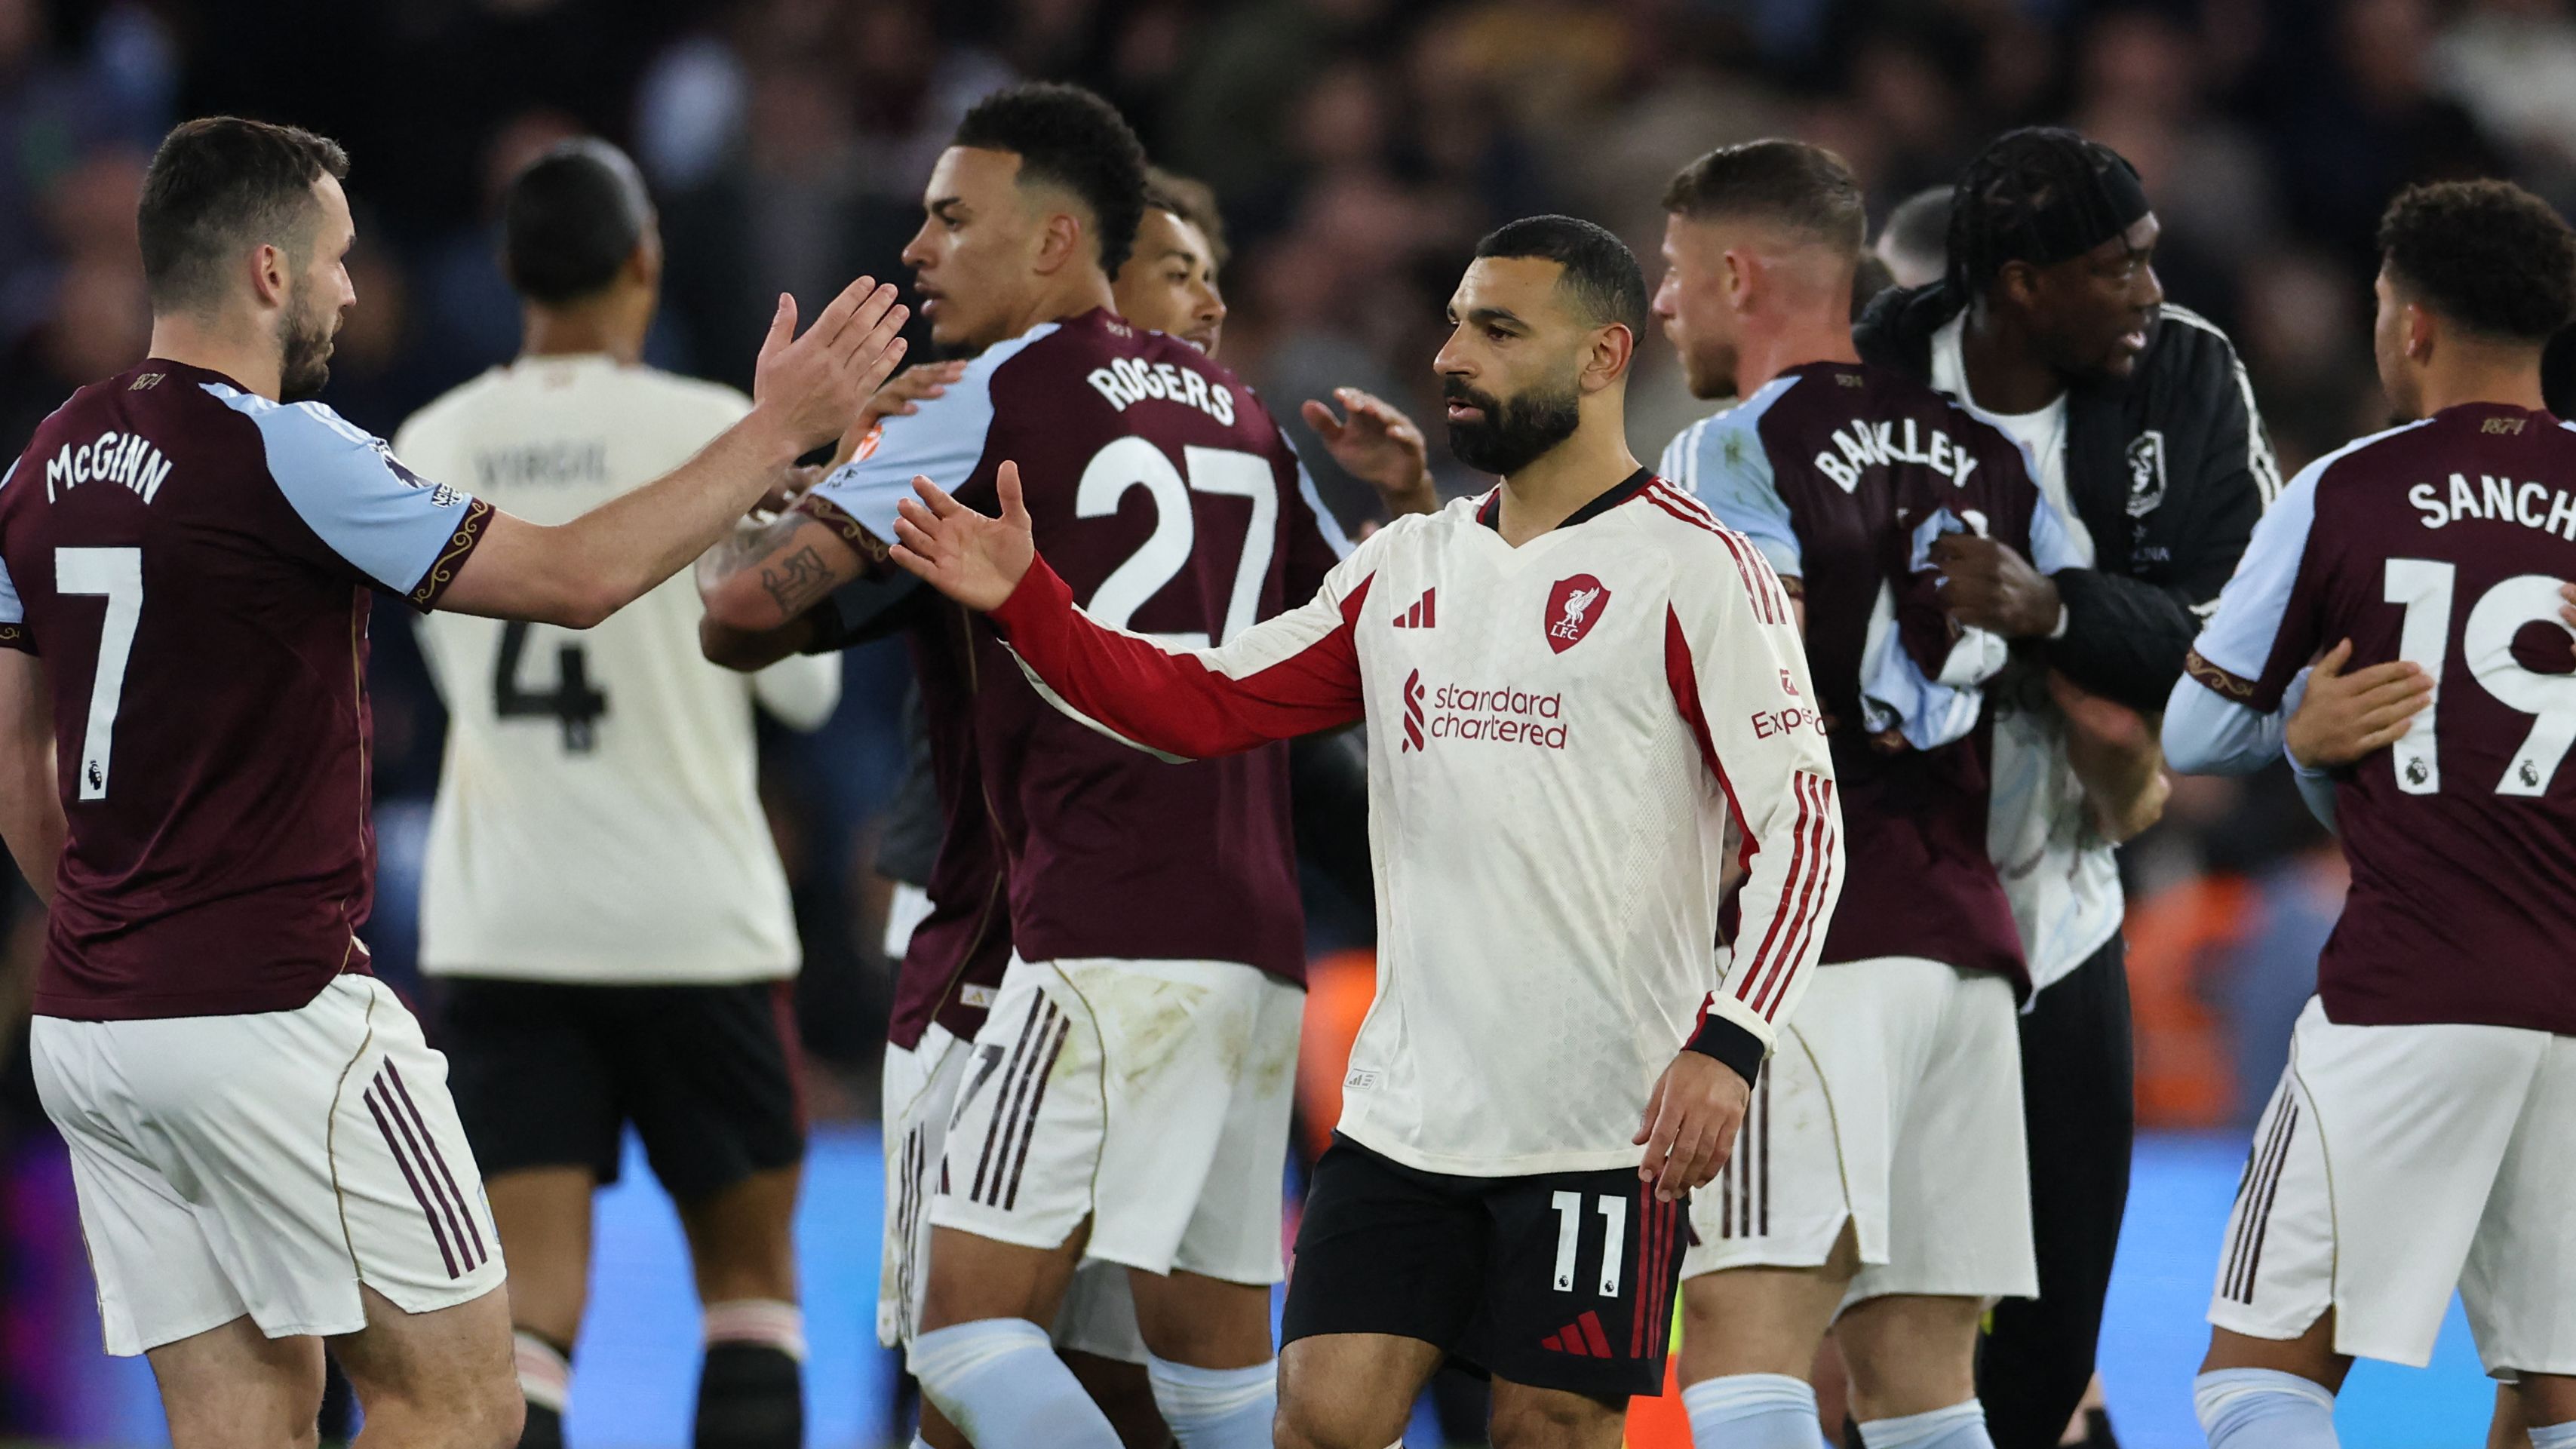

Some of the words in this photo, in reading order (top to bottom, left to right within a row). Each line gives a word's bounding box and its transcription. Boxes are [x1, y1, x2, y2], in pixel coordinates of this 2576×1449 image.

[1087, 357, 1235, 426] ROGERS
[1814, 418, 1979, 494] BARKLEY
[1076, 434, 1279, 653] 27
[54, 547, 144, 801] 7
[493, 620, 609, 754] 4
[1434, 683, 1561, 719] standard
[2384, 558, 2576, 797] 19
[1432, 712, 1567, 749] chartered
[1552, 1190, 1627, 1297] 11
